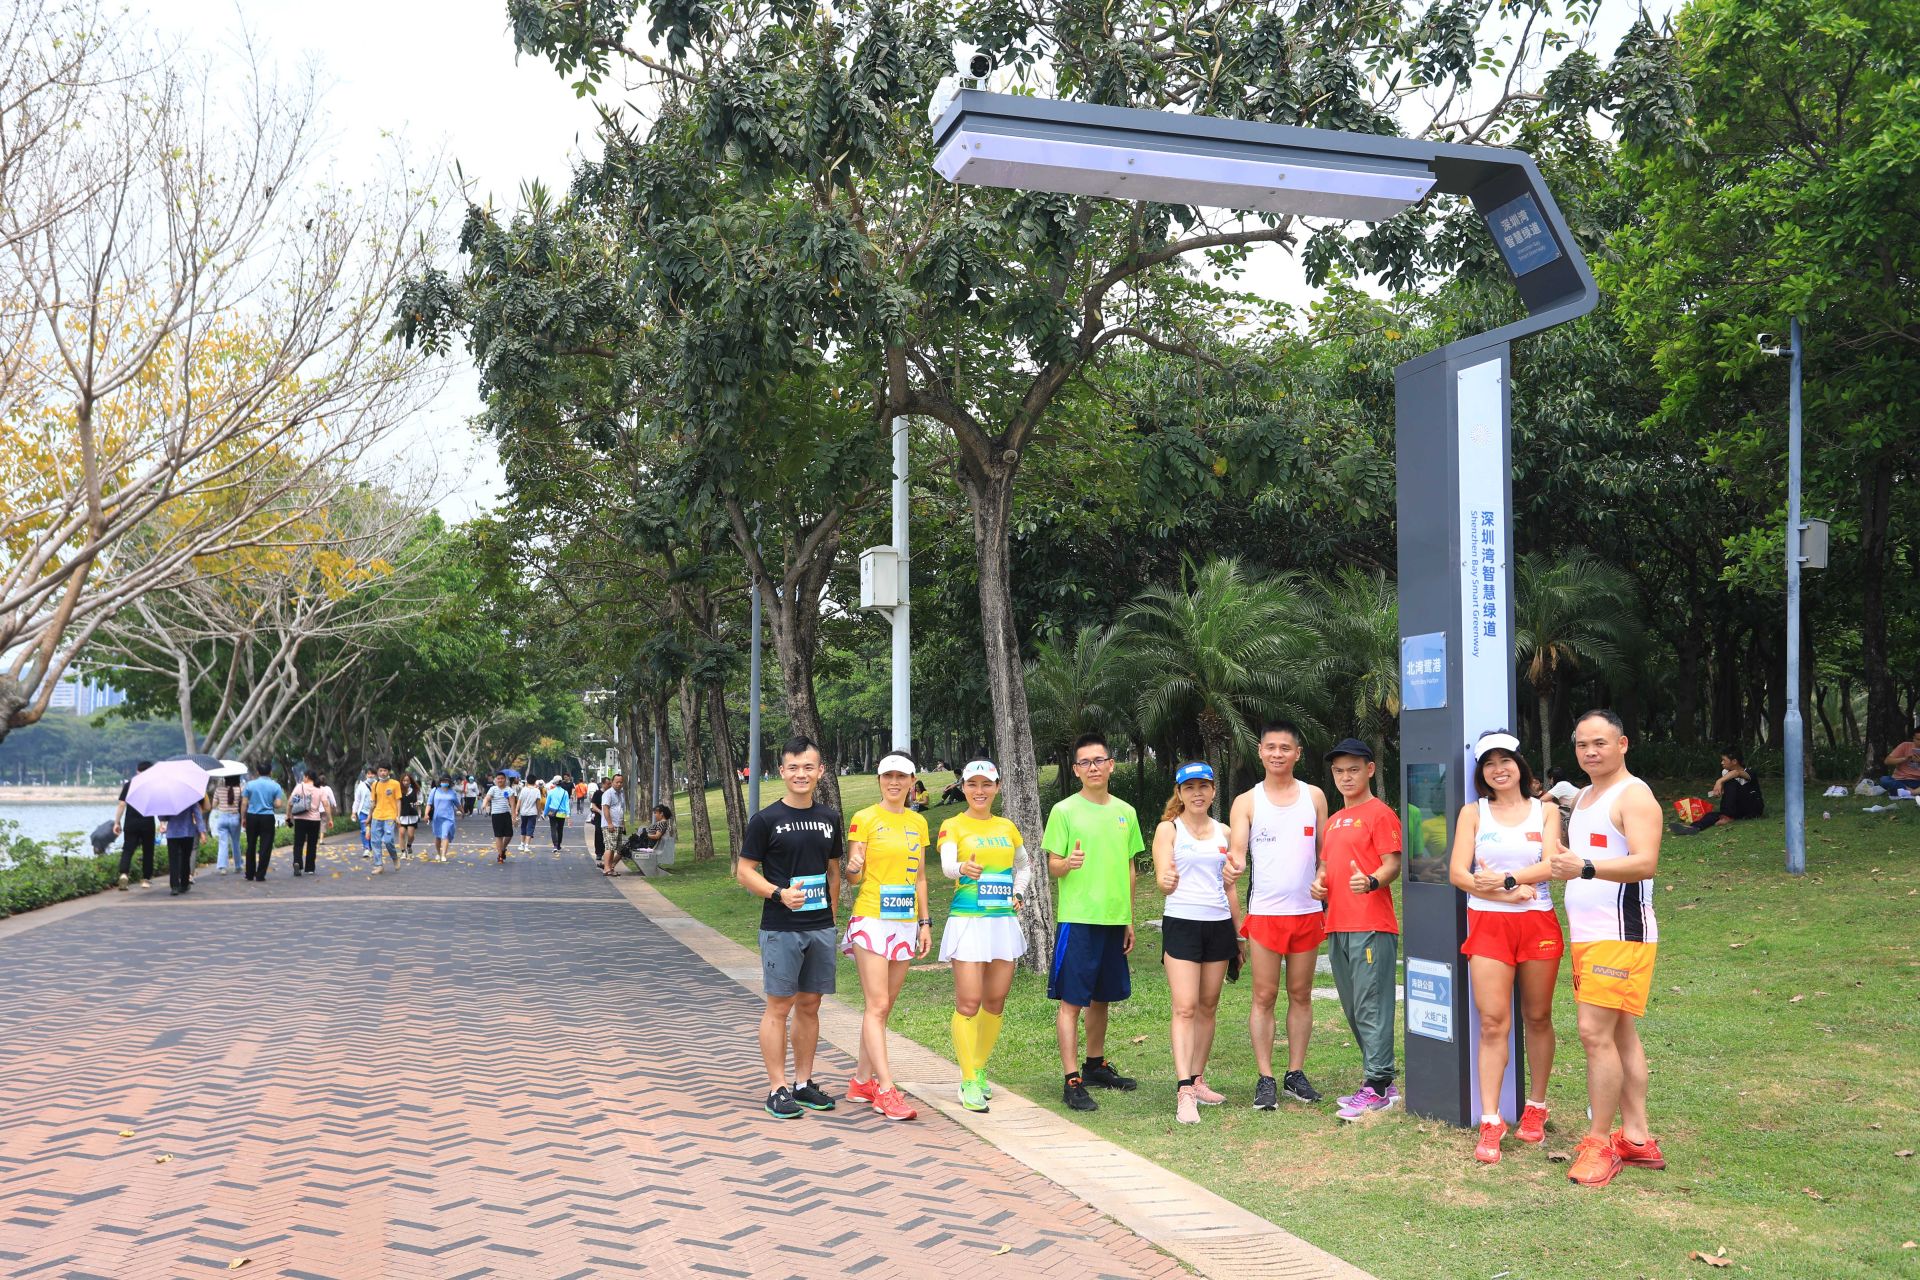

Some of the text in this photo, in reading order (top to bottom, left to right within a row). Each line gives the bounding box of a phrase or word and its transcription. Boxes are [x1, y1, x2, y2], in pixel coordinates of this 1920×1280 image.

[1501, 209, 1530, 232] 深圳湾
[1504, 221, 1542, 248] 智慧绿道
[1471, 510, 1480, 658] Shenzhen Bay Smart Greenway
[1481, 511, 1497, 638] 深圳湾智慧绿道
[800, 886, 825, 899] Z0114
[979, 884, 1012, 896] SZ0333
[883, 896, 914, 908] SZ0066
